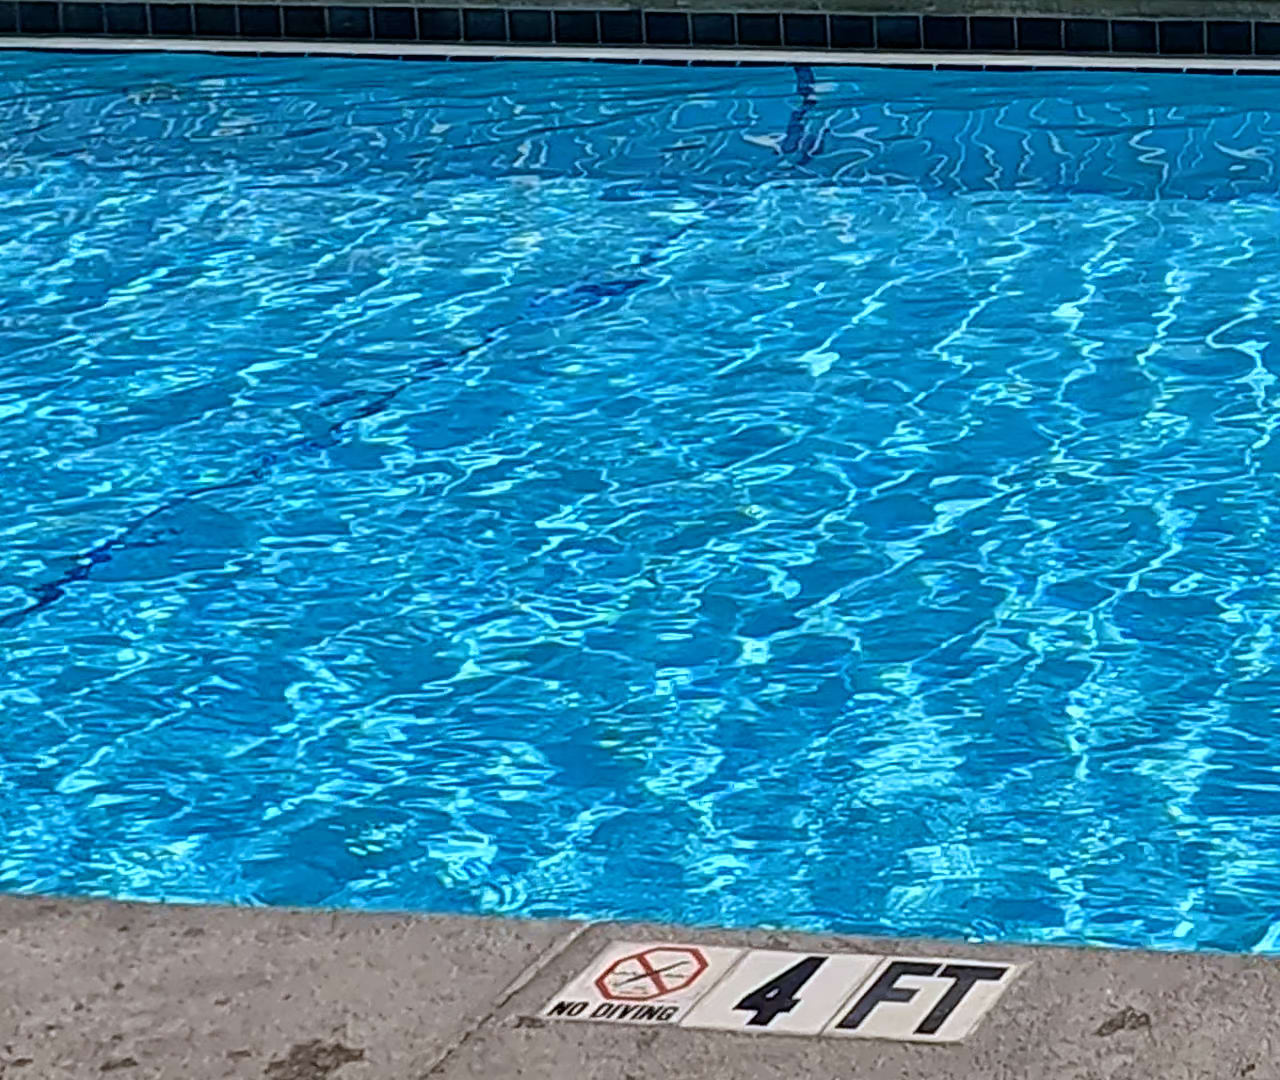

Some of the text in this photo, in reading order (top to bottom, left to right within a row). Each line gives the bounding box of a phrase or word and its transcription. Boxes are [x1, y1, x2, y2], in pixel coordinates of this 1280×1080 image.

[547, 1001, 679, 1021] NO DIVING
[732, 956, 1010, 1034] 4 FT
